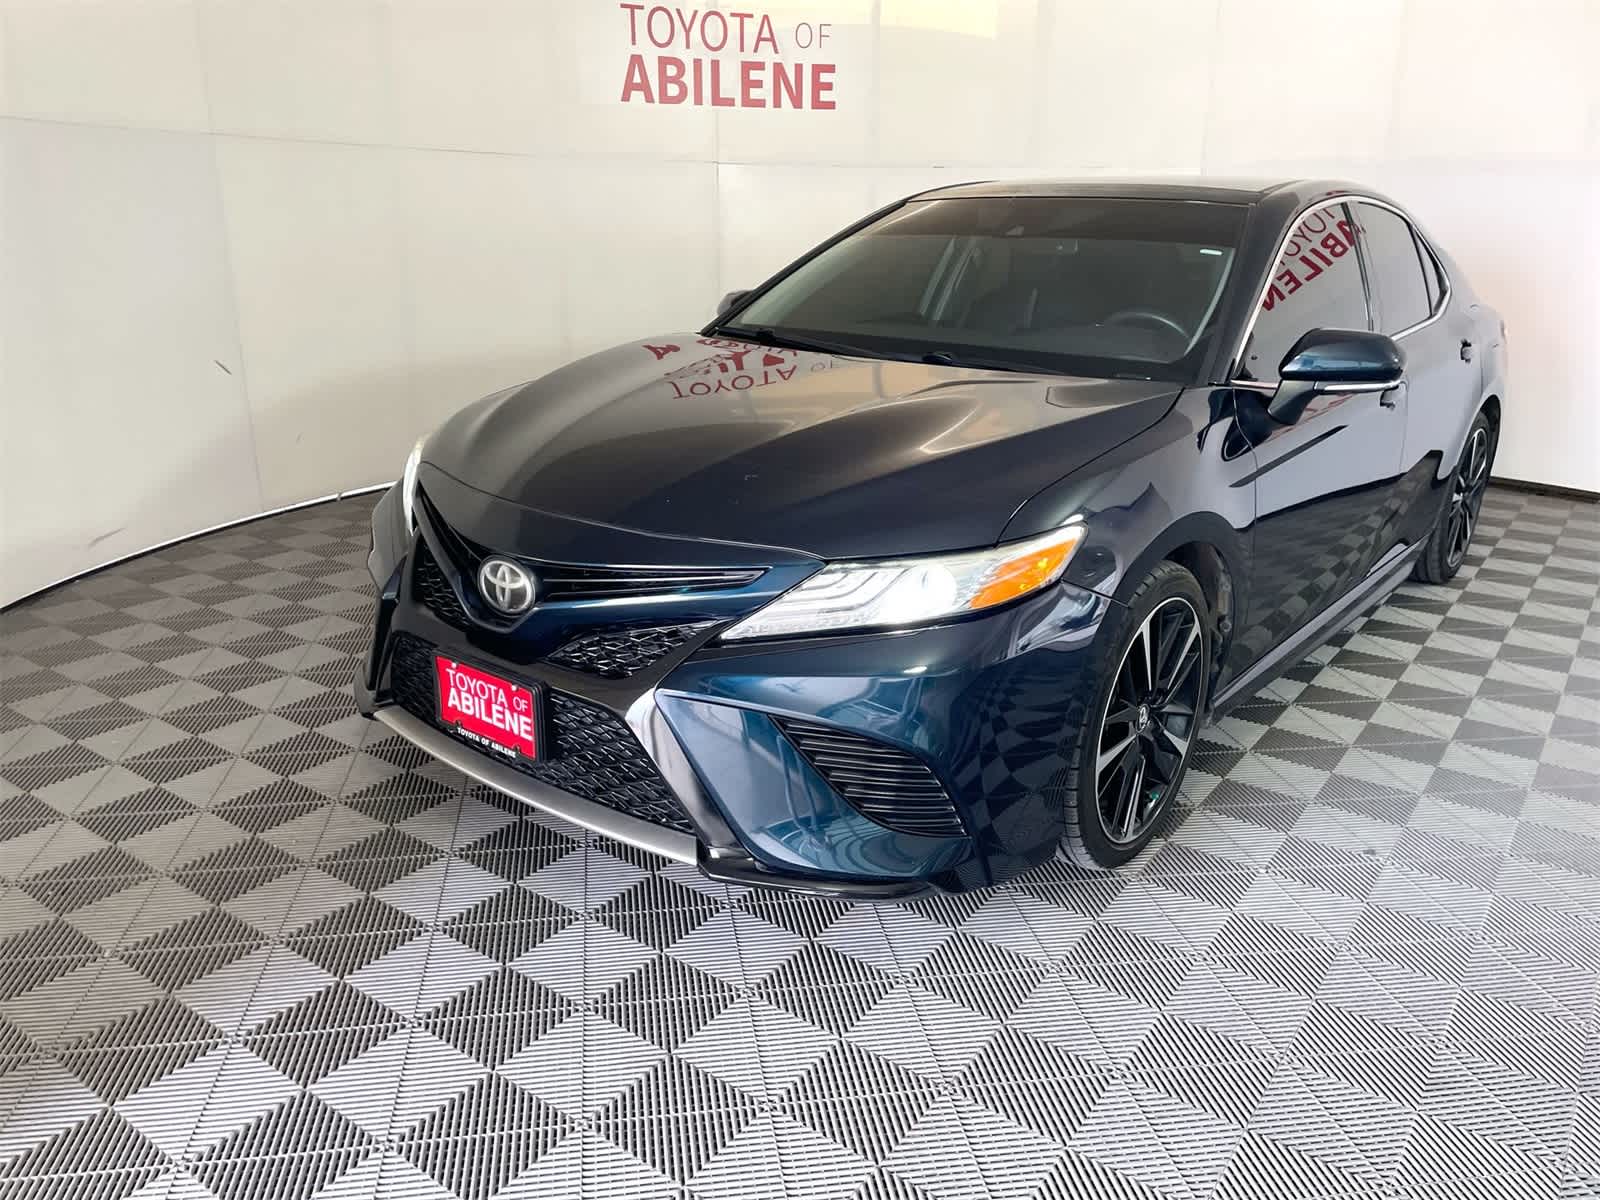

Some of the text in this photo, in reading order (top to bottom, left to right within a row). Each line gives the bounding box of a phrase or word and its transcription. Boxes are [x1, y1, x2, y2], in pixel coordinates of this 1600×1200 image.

[620, 3, 832, 54] TOYOTA OF
[620, 54, 836, 110] ABILENE
[445, 668, 528, 712] TOYOTA OF
[447, 687, 534, 741] ABILENE
[457, 727, 516, 758] TOYOTA OF ABILENE
